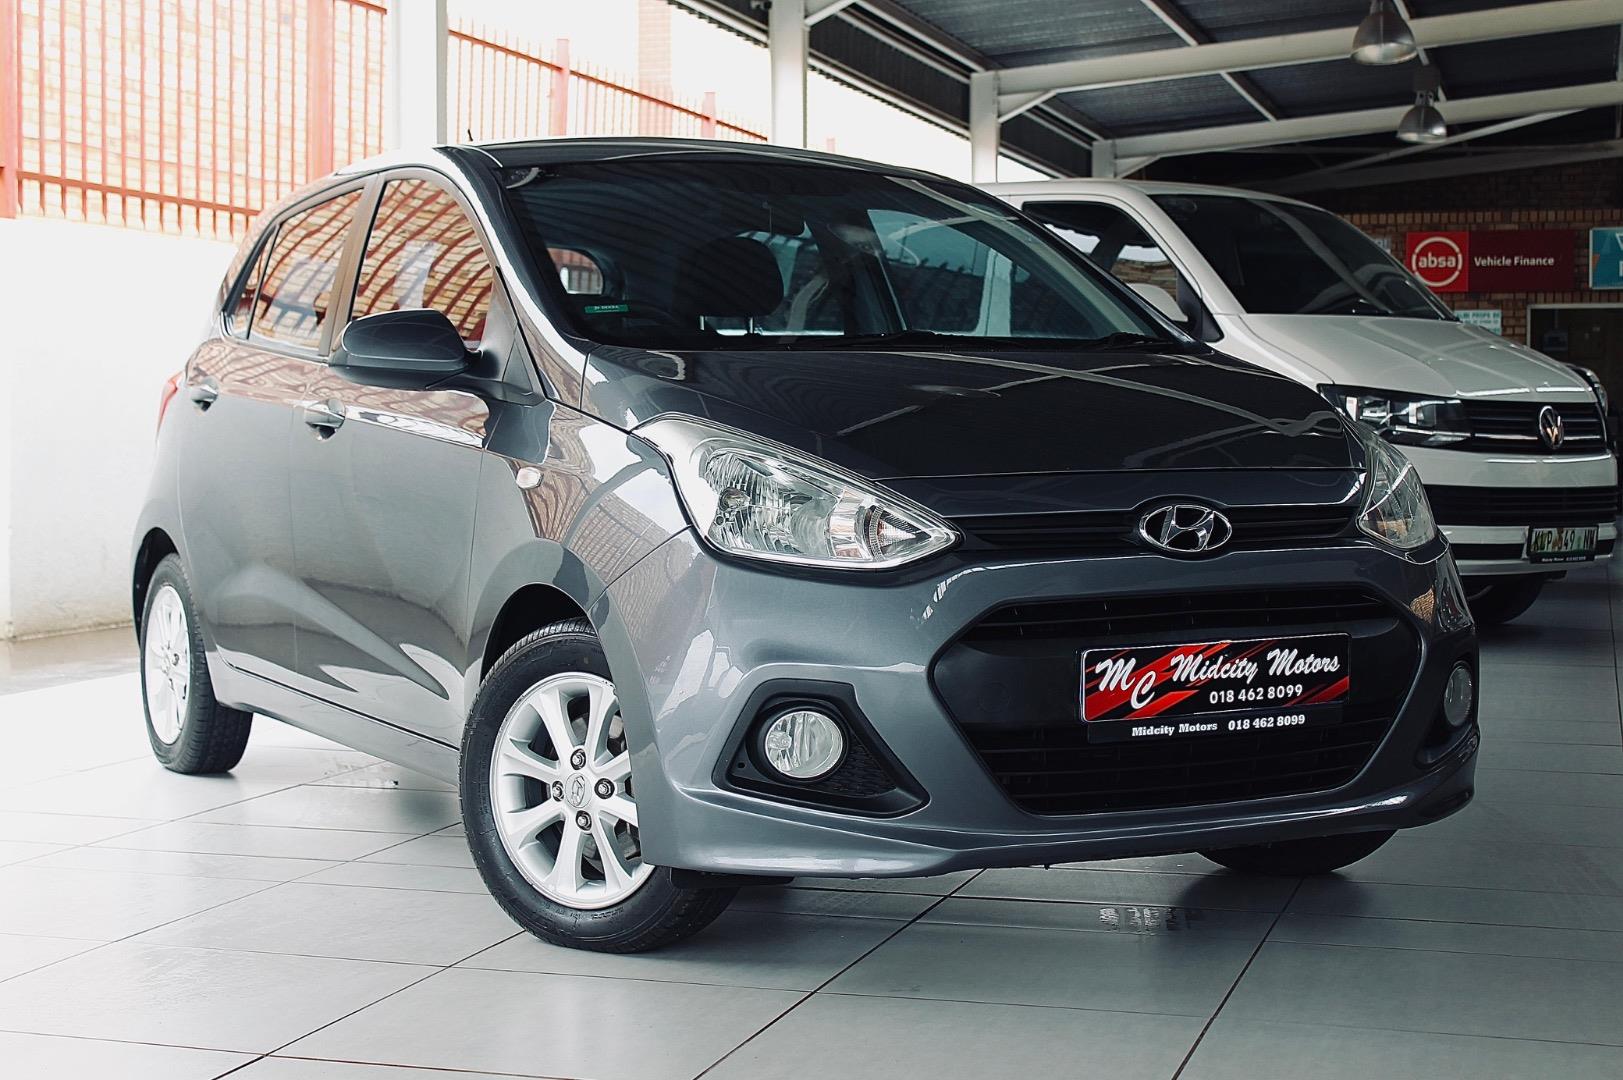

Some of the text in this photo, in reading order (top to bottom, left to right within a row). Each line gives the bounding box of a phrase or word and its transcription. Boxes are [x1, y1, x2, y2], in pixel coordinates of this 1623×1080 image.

[1418, 252, 1456, 268] absa
[1474, 256, 1555, 267] Vehicle Finance
[1170, 648, 1341, 684] Midcity Motors
[1209, 684, 1303, 704] 018 462 8099
[1132, 714, 1306, 737] Midcity Motors 018 462 8099
